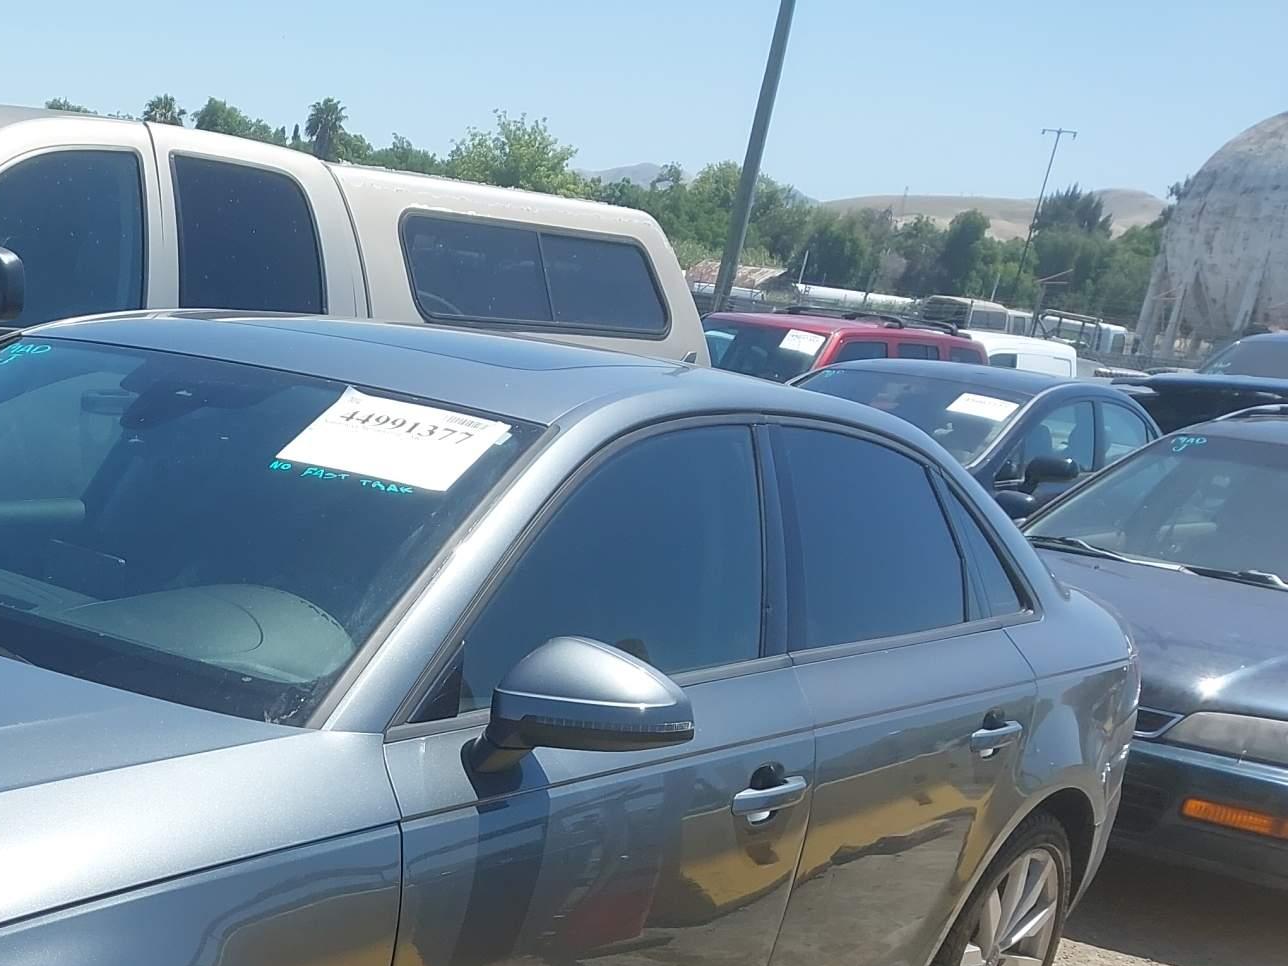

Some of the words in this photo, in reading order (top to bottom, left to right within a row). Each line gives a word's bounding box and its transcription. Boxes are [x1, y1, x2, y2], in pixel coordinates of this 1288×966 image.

[339, 410, 474, 444] 44991377
[269, 460, 292, 470] NO
[301, 466, 350, 480] FAST
[360, 479, 414, 494] TRAK
